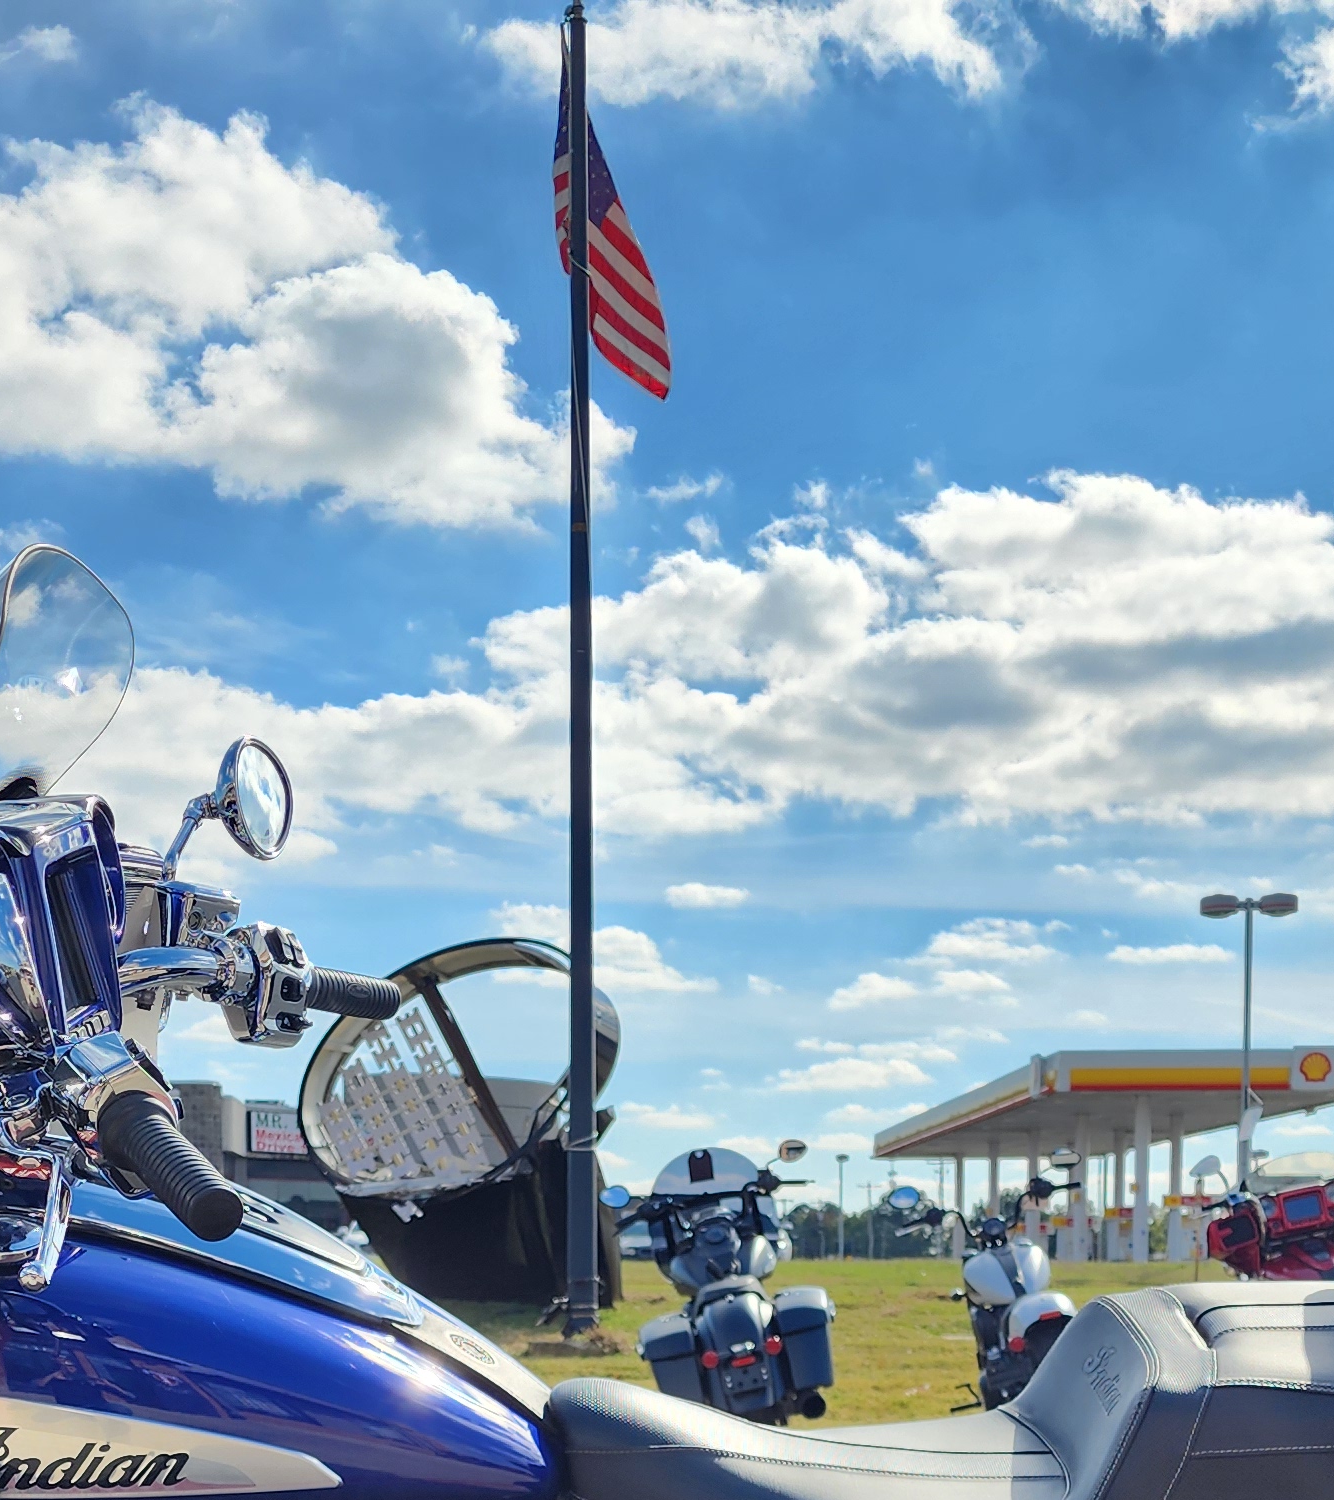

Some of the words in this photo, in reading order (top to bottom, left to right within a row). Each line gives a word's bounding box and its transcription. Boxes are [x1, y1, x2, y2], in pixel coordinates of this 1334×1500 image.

[256, 1113, 288, 1129] MR.
[256, 1129, 303, 1141] Mexica
[256, 1141, 296, 1151] Drive
